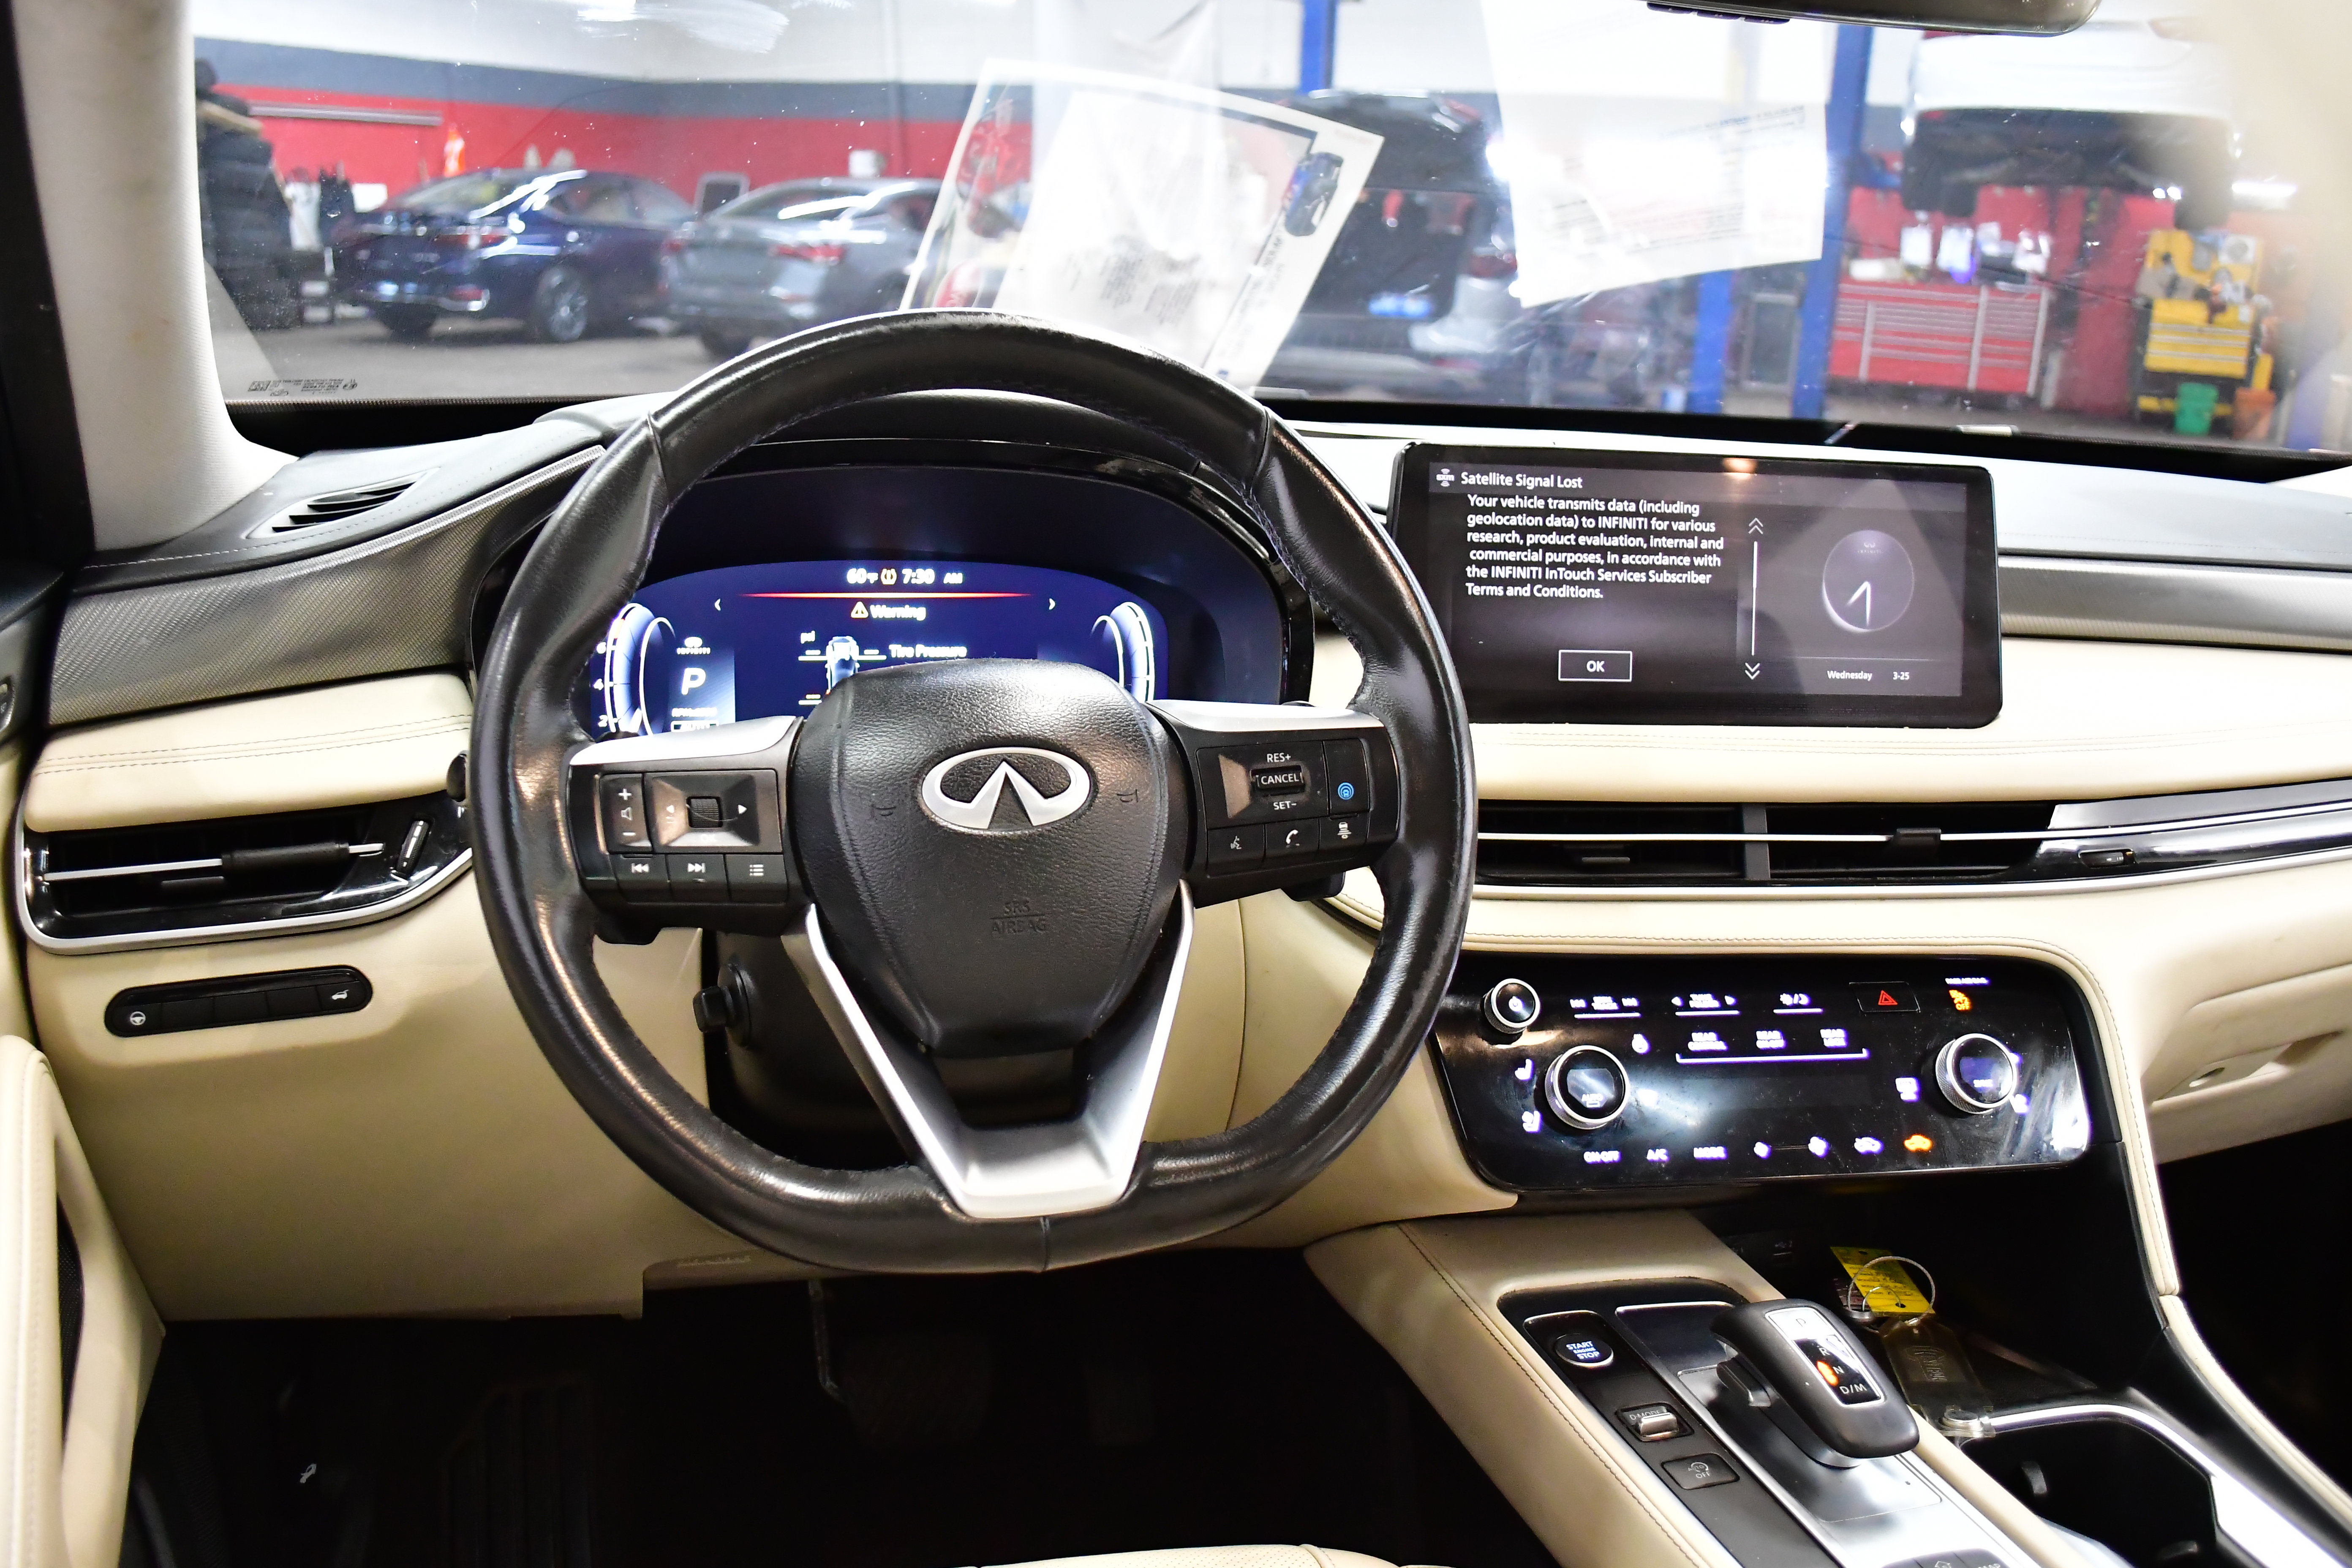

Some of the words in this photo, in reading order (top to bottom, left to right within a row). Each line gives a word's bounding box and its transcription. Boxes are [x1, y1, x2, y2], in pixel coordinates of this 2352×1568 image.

[1461, 472, 1513, 486] Satellite
[1516, 474, 1554, 490] Signal
[1557, 475, 1582, 488] Lost
[1467, 494, 1498, 507] Your
[1500, 495, 1544, 509] vehicle
[1547, 497, 1605, 511] transmits
[1608, 498, 1636, 512] data
[1639, 499, 1699, 517] (including
[1467, 512, 1543, 527] geolocation
[1546, 514, 1579, 529] data)
[1581, 517, 1595, 528] to
[1598, 516, 1647, 530] INFINITI
[1651, 517, 1669, 530] for
[1671, 520, 1715, 532] various
[1467, 530, 1524, 545] research,
[1526, 531, 1576, 546] product
[1578, 533, 1647, 549] evaluation,
[1650, 535, 1698, 549] internal
[1700, 537, 1723, 549] and
[1470, 549, 1542, 561] commercial
[1545, 552, 1604, 565] purposes,
[1607, 551, 1619, 564] in
[1622, 553, 1690, 566] accordance
[1693, 554, 1721, 566] with
[902, 569, 935, 584] 7:30
[943, 572, 963, 584] AM
[1465, 564, 1488, 578] the
[1491, 566, 1541, 579] INFINITI
[1545, 567, 1595, 580] InTouch
[1598, 569, 1646, 582] Services
[1649, 570, 1712, 584] Subscriber
[1465, 583, 1504, 596] Terms
[1506, 583, 1531, 596] and
[1533, 585, 1603, 598] Conditions.
[870, 605, 926, 621] Warning
[596, 642, 606, 653] 6
[889, 644, 914, 658] Tire
[916, 644, 967, 658] Pressure
[1586, 660, 1604, 673] OK
[681, 667, 706, 695] P
[1827, 670, 1872, 681] Wednesday
[1893, 672, 1909, 680] 3-25
[593, 678, 604, 690] 4
[598, 715, 608, 727] 2
[1267, 753, 1291, 763] RES+
[1261, 773, 1299, 785] CANCEL
[1647, 1149, 1669, 1161] A/C
[1693, 1146, 1727, 1159] MODE
[1566, 1341, 1593, 1350] START
[1818, 1348, 1830, 1356] R
[1833, 1365, 1844, 1374] N
[1839, 1383, 1867, 1394] D/M
